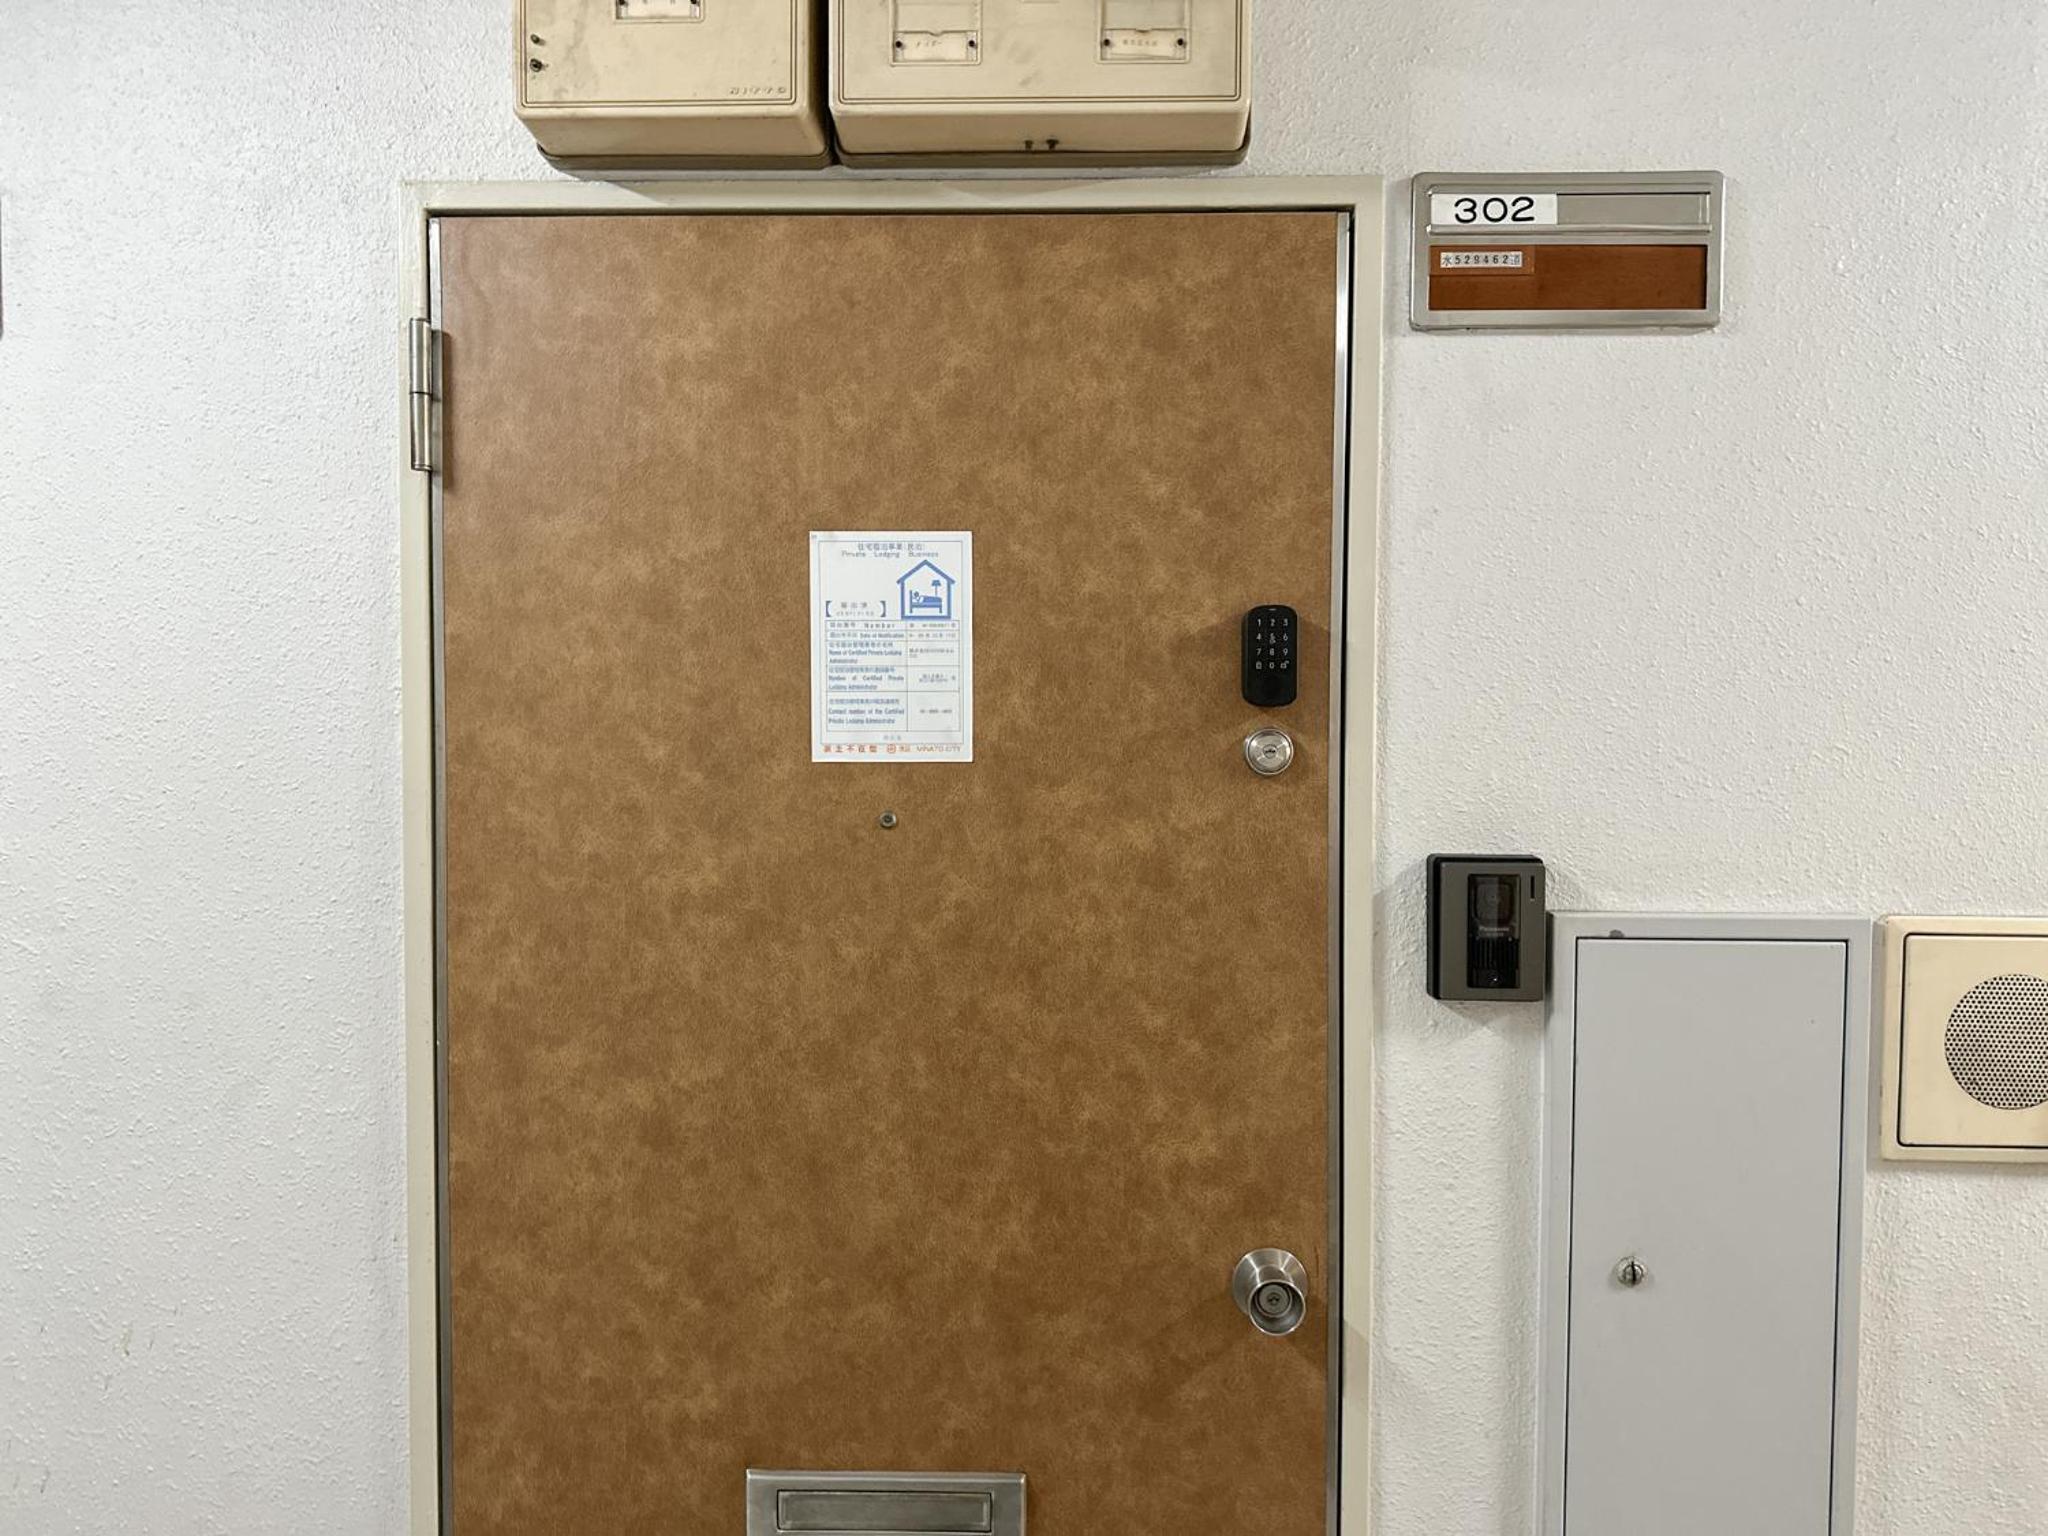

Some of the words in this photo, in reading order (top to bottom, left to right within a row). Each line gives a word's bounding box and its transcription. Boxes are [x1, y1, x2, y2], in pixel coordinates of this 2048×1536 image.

[1454, 196, 1535, 224] 302
[1257, 618, 1262, 627] 1
[1270, 618, 1276, 627] 2
[1283, 618, 1288, 627] 3
[1256, 632, 1262, 640] 4
[1283, 633, 1288, 641] 6
[1256, 648, 1262, 656] 7
[1269, 648, 1275, 656] 8
[1283, 648, 1288, 656] 9
[1269, 661, 1275, 669] 0
